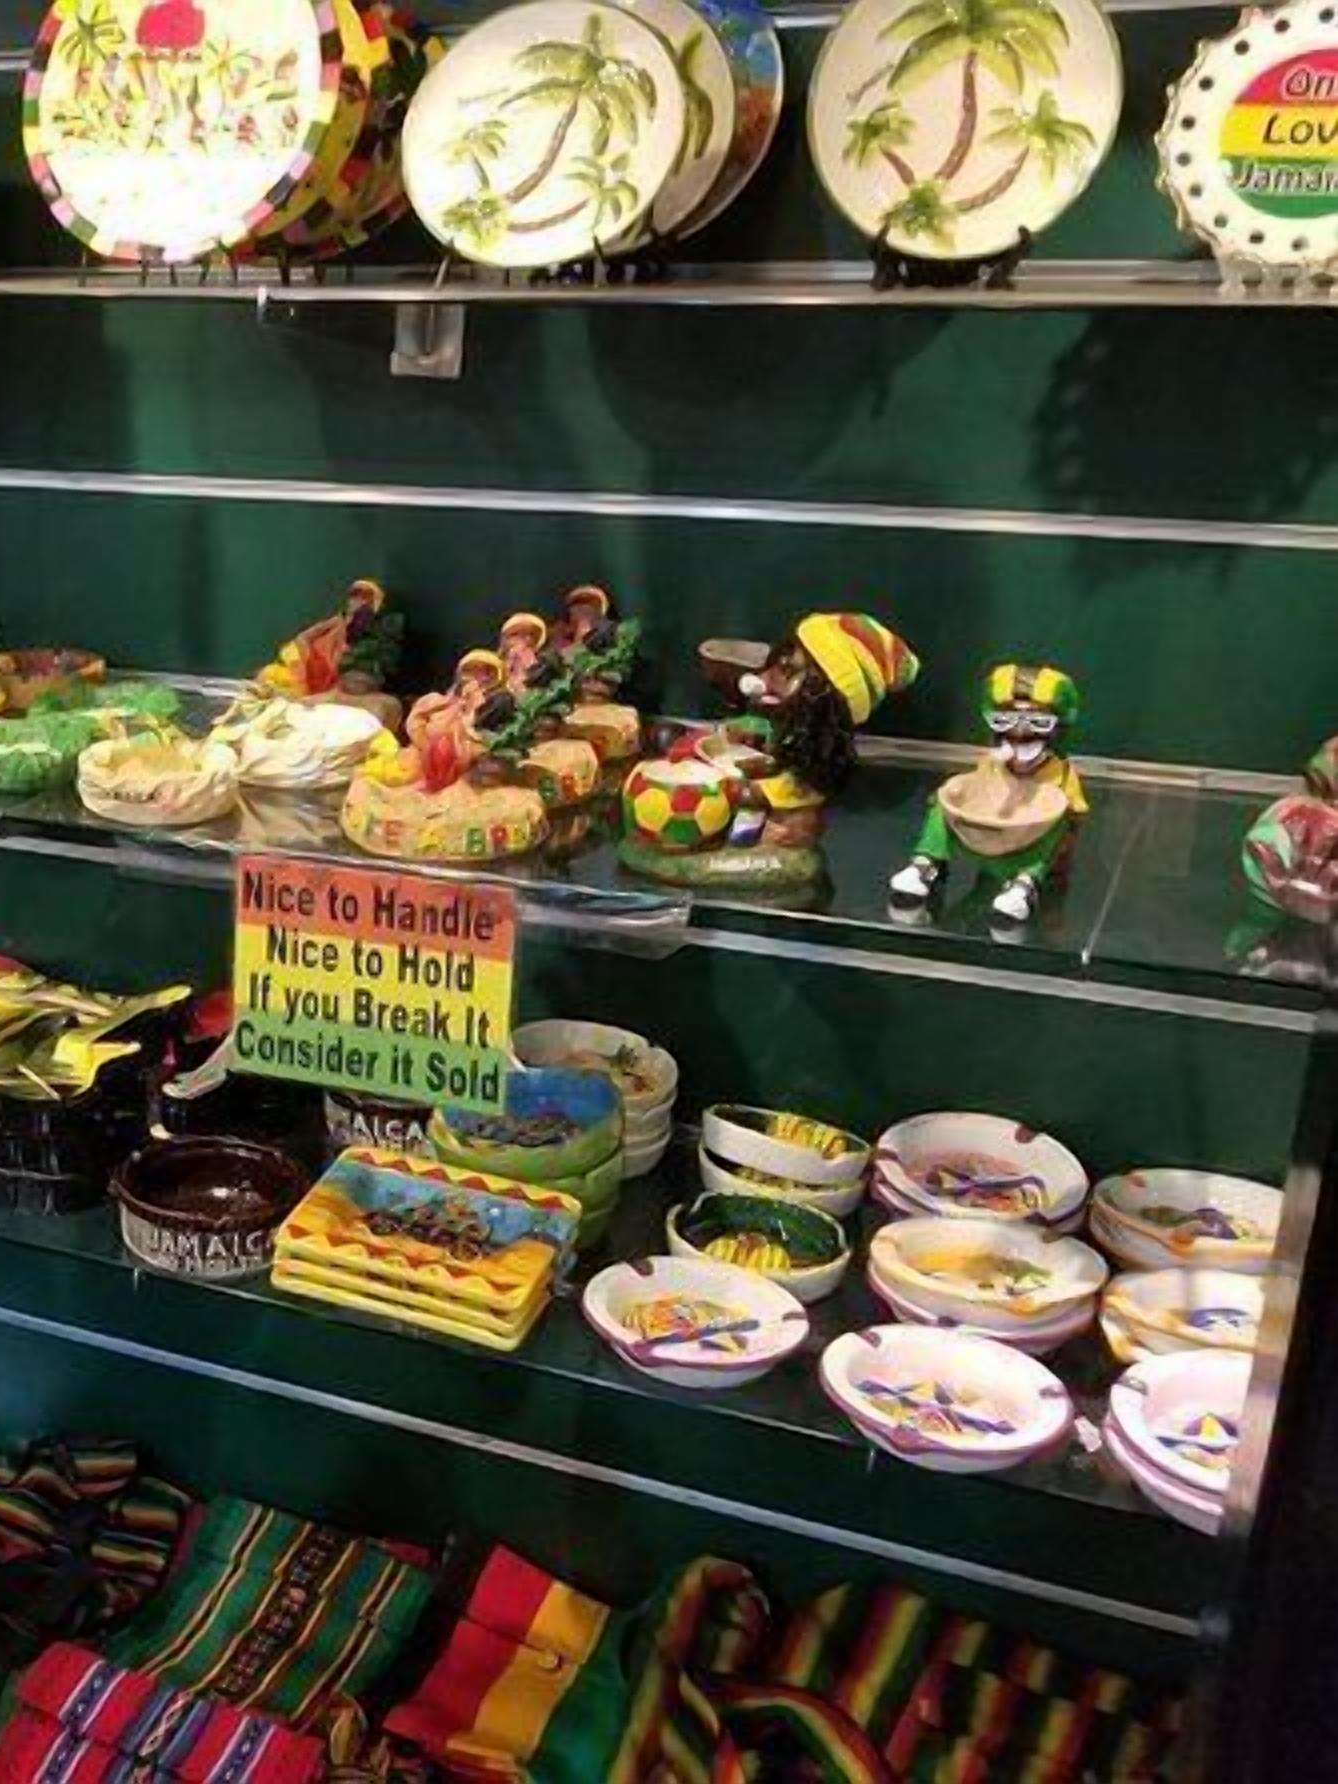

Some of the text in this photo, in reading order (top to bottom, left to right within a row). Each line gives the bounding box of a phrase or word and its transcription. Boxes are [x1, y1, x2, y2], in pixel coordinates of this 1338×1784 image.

[242, 871, 495, 941] Nice to Handle
[267, 924, 475, 992] Nice to Hold
[249, 972, 490, 1049] If you Break It
[234, 1019, 500, 1103] Consider it Sold
